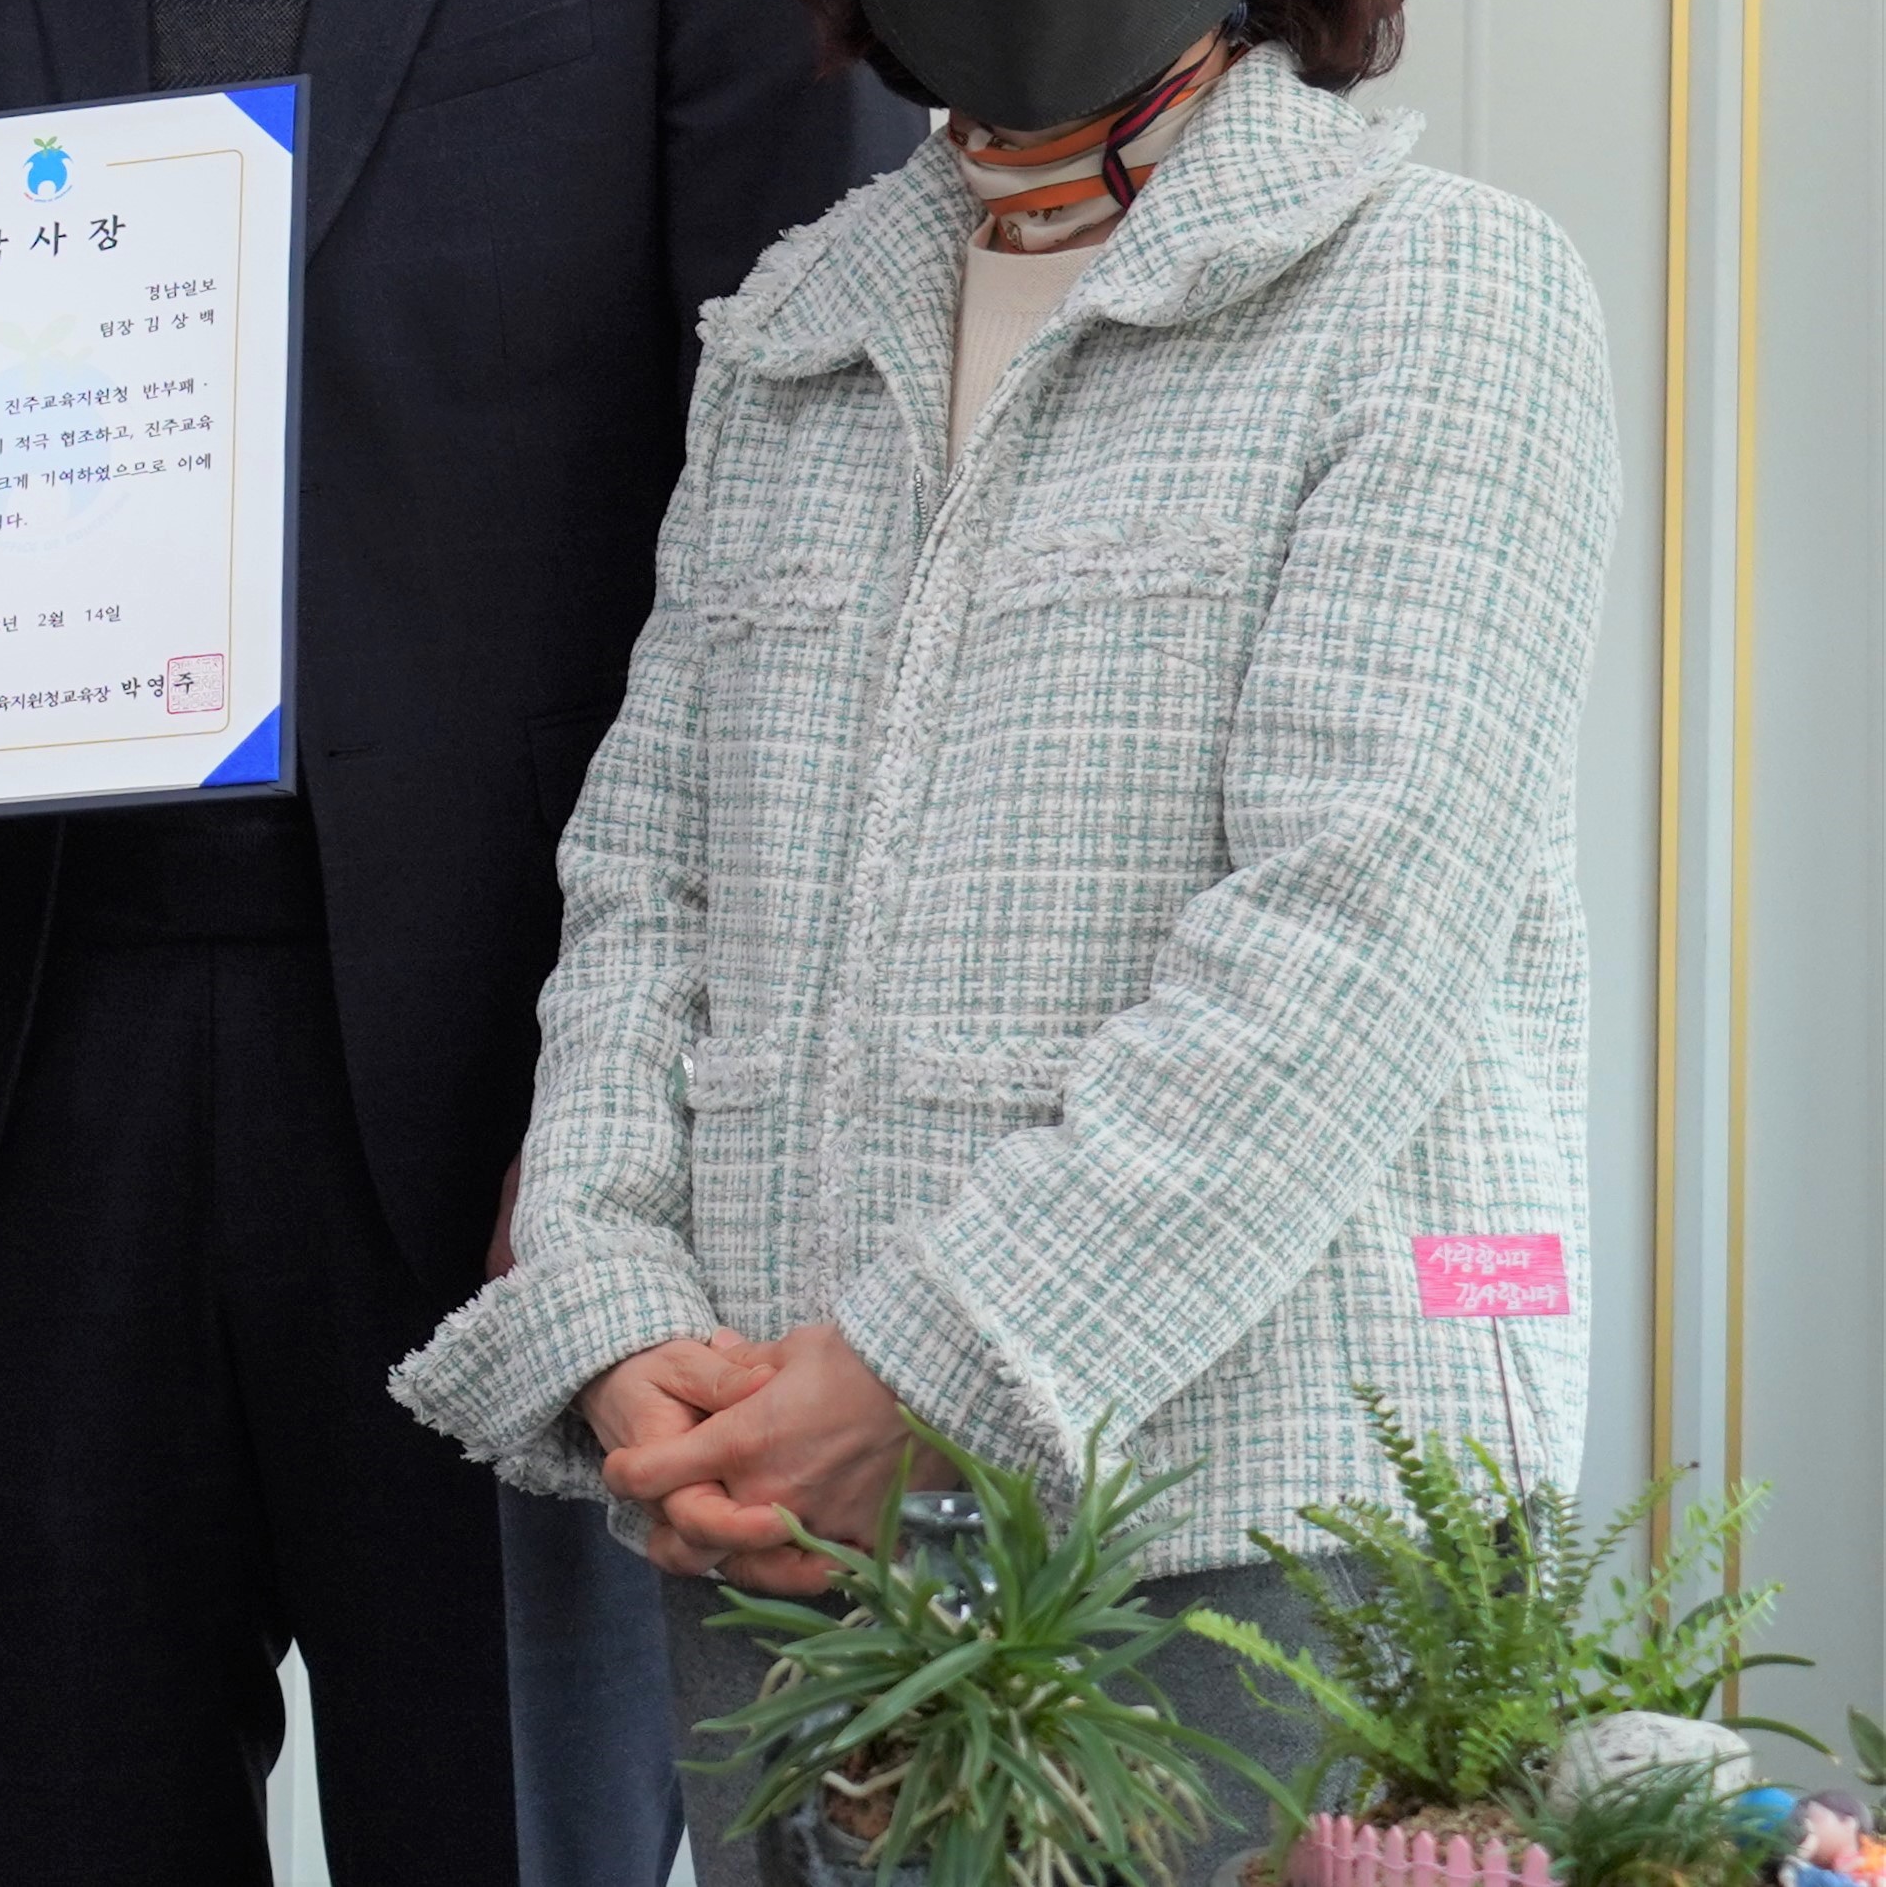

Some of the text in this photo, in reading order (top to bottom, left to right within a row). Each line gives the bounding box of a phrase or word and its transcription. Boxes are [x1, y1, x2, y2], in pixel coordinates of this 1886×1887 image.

[146, 279, 216, 301] 경남일보
[101, 319, 134, 337] 팀장
[6, 386, 127, 415] 진주교육지원청
[16, 433, 49, 451] 적극
[61, 426, 133, 447] 협조하고,
[146, 415, 213, 437] 진주교육
[41, 460, 166, 487] 기여하였으므로
[178, 453, 211, 471] 이에
[39, 611, 64, 628] 2월
[86, 605, 120, 622] 14일
[1428, 1241, 1531, 1274] 사랑합니다
